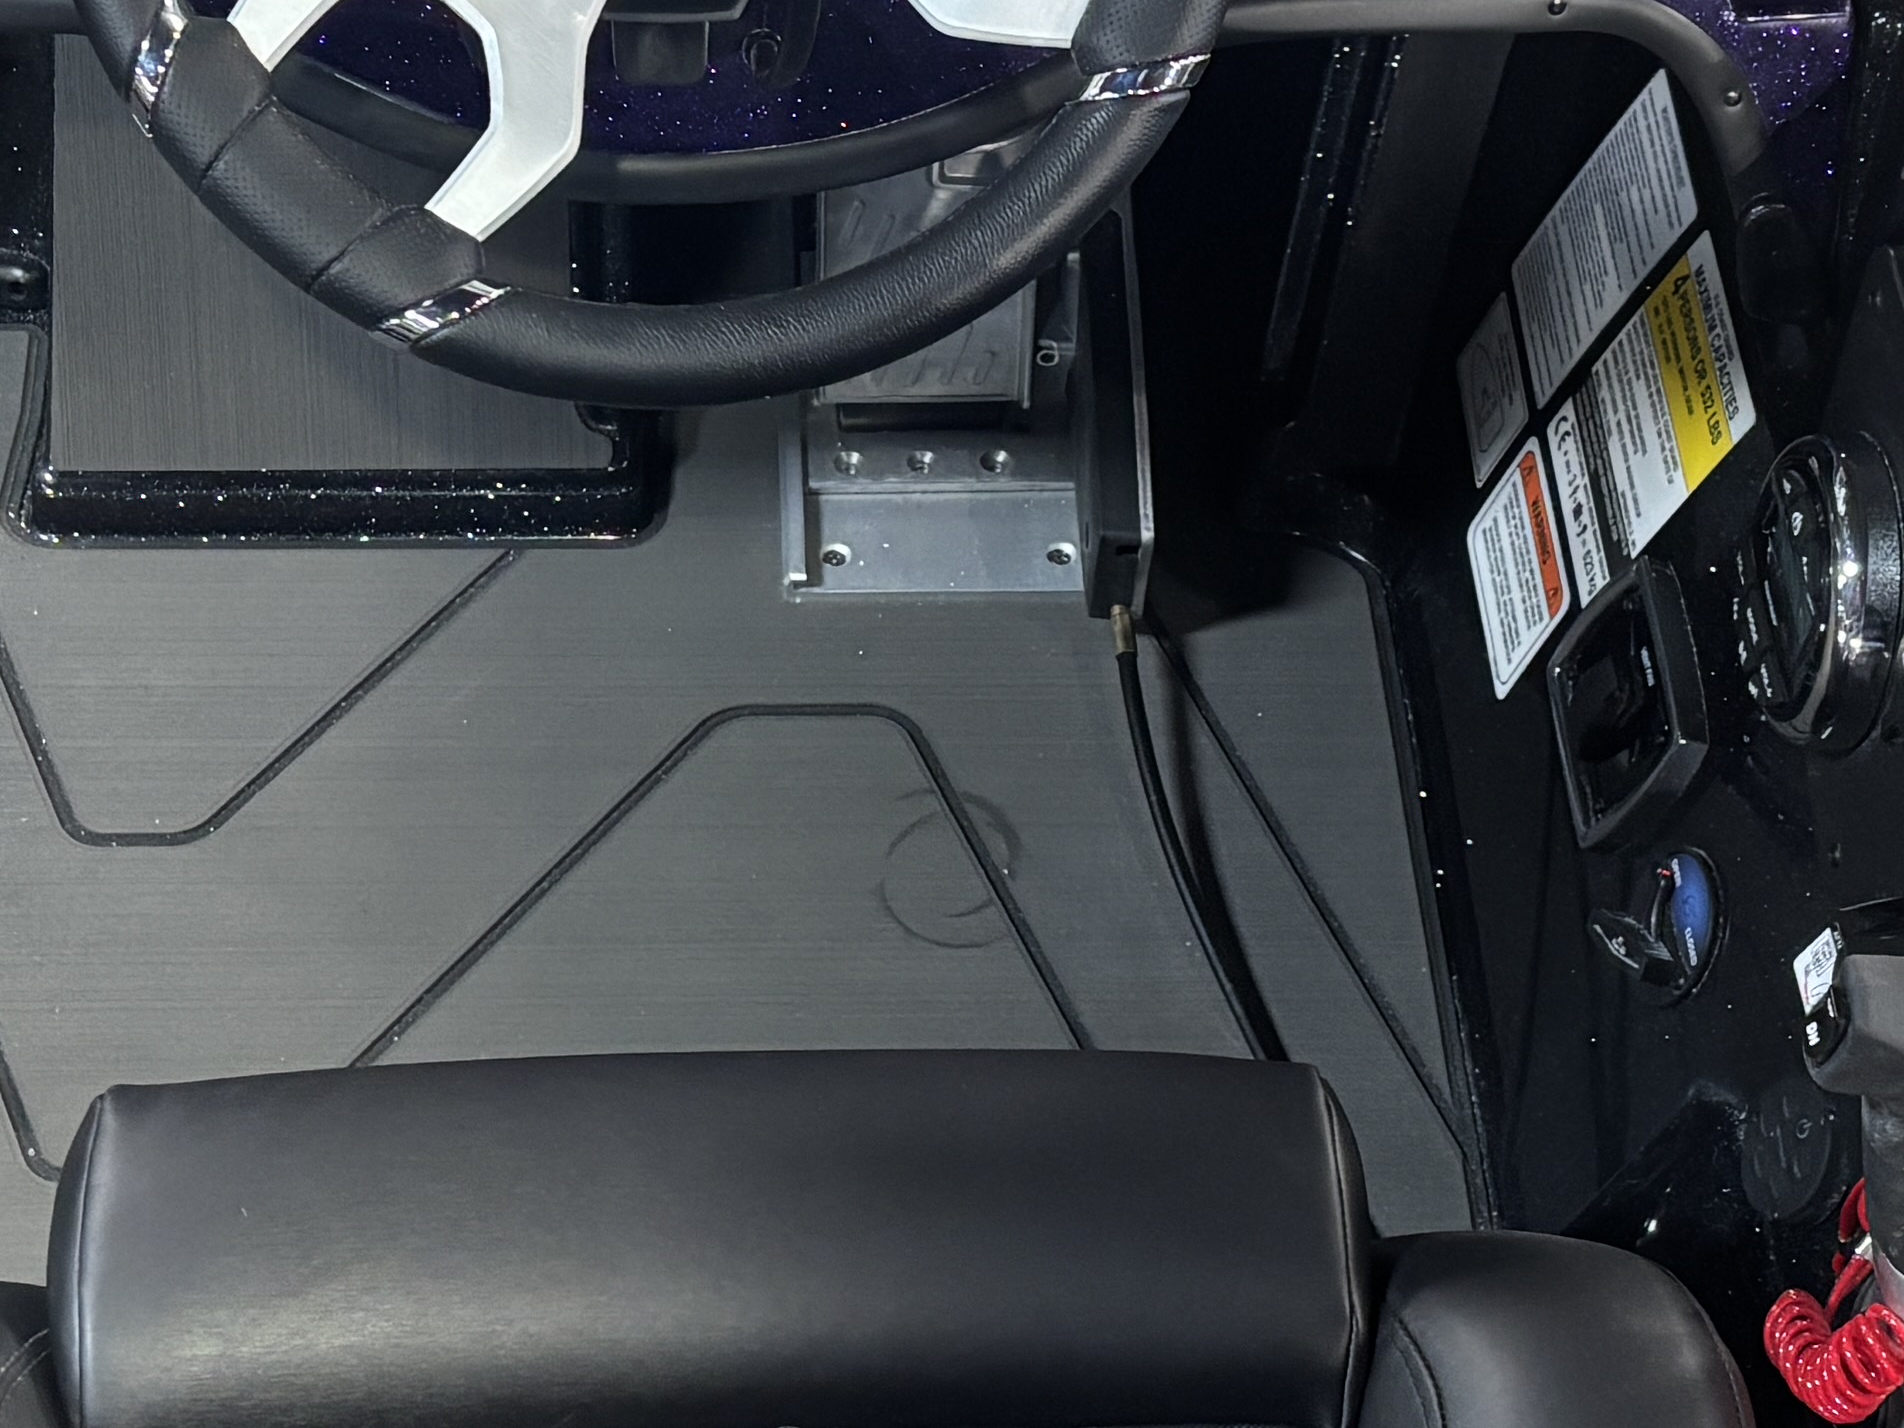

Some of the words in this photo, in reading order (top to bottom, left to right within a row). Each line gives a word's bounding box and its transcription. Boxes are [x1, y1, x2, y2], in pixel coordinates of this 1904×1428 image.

[1669, 264, 1691, 300] 4
[1705, 407, 1723, 449] LBS
[1709, 329, 1740, 423] CAPACITIES
